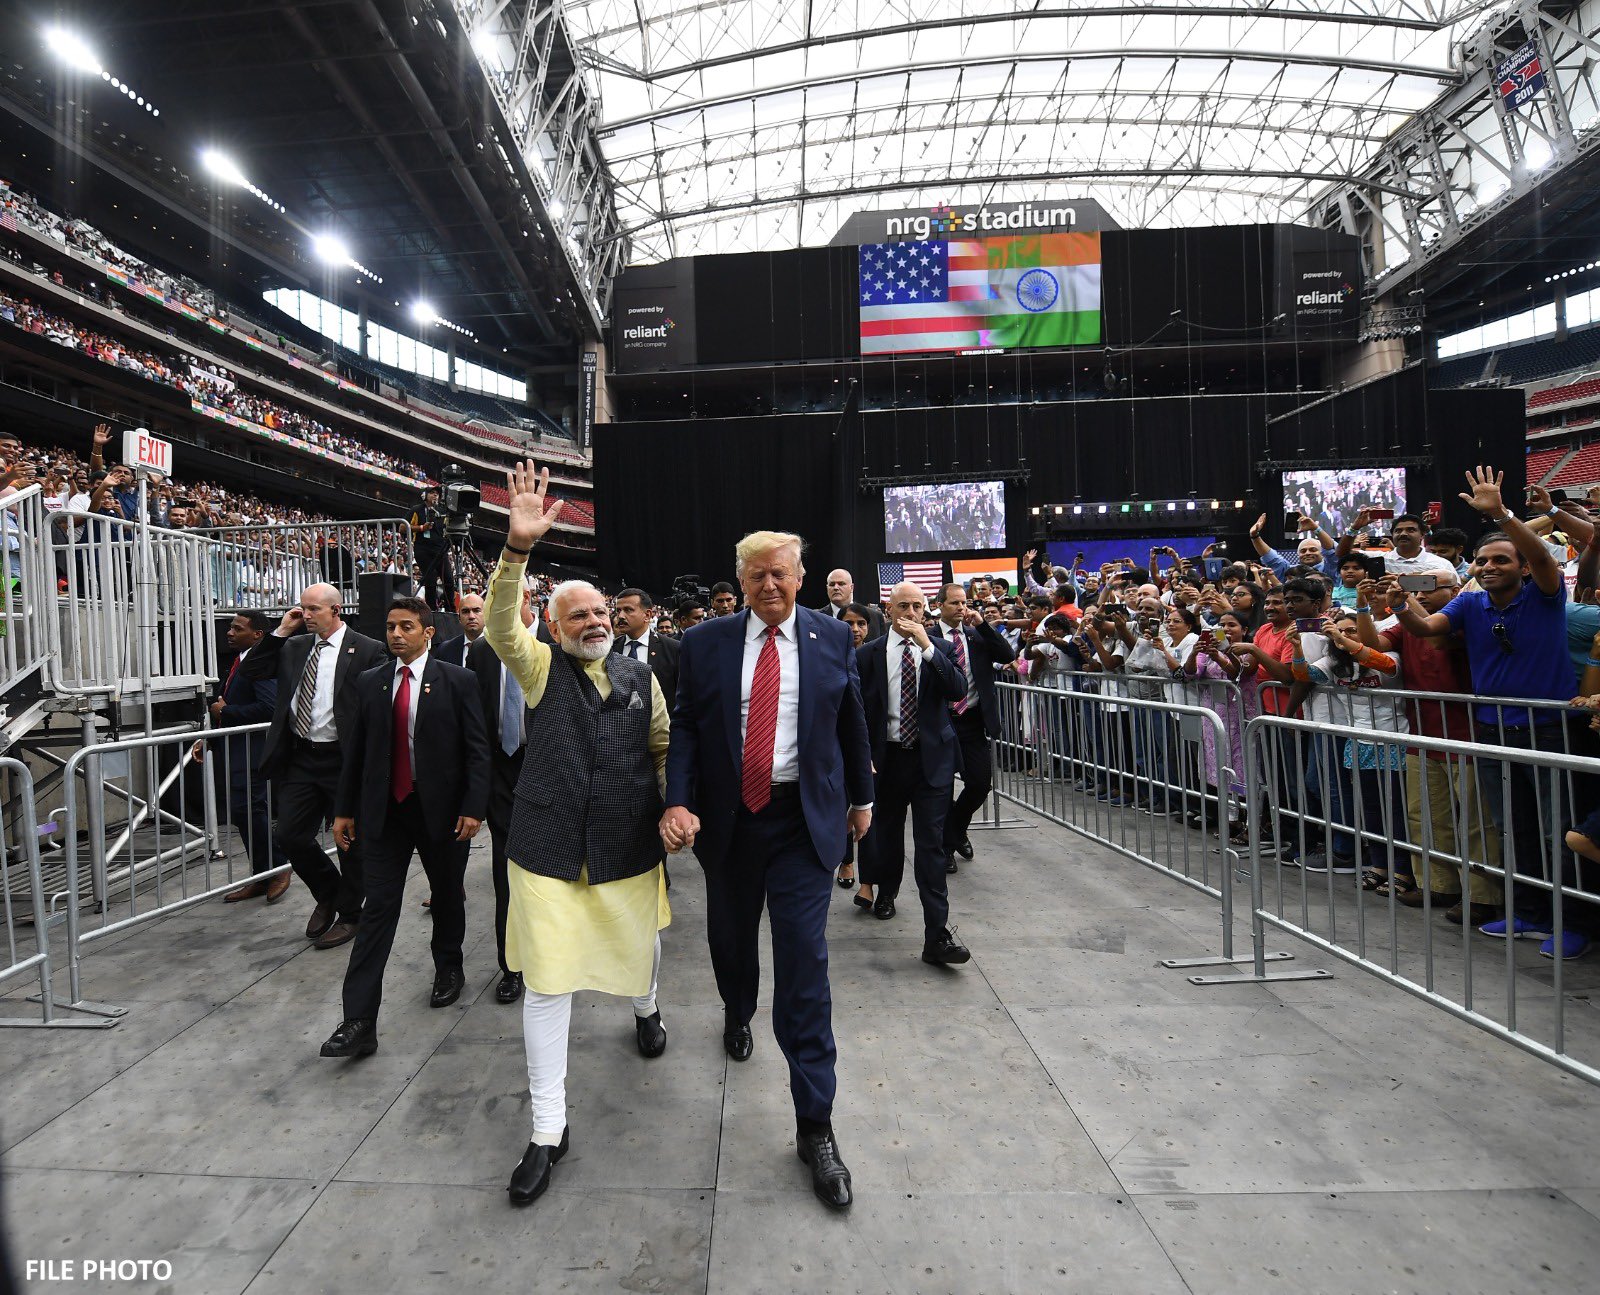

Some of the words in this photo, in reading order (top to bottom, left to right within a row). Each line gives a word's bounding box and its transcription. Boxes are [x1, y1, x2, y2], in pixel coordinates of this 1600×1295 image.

[1497, 48, 1535, 80] CHAMPIONS
[1500, 58, 1511, 71] AFC
[1510, 45, 1529, 61] SOUTH
[1514, 84, 1534, 104] 2011
[886, 215, 931, 241] nrg
[963, 203, 1077, 231] stadium
[1303, 271, 1333, 280] powered
[1333, 270, 1342, 279] by
[1296, 290, 1344, 305] reliant
[628, 306, 655, 315] powered
[655, 305, 664, 314] by
[624, 324, 667, 339] reliant
[138, 435, 167, 468] EXIT
